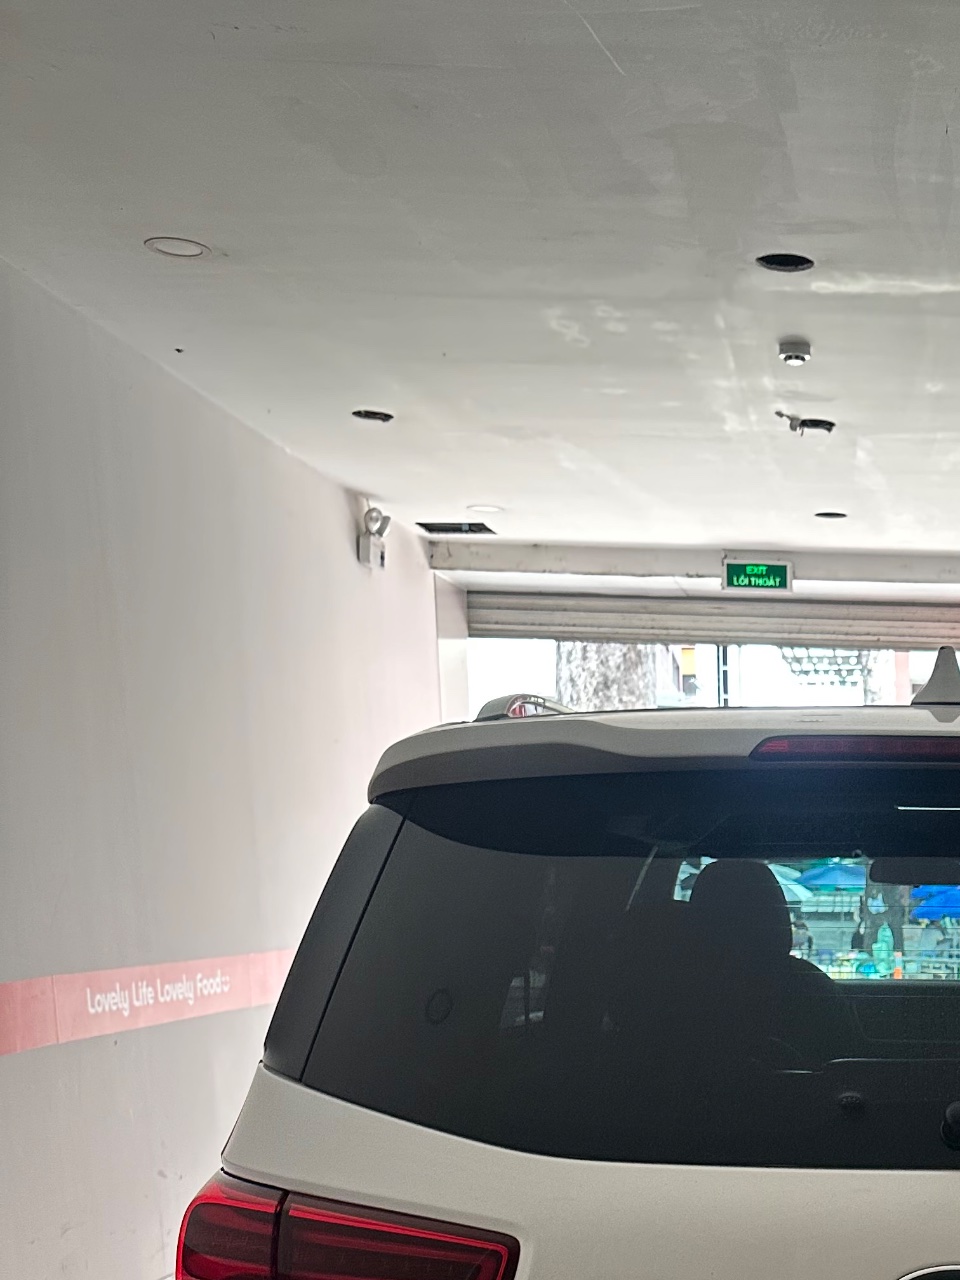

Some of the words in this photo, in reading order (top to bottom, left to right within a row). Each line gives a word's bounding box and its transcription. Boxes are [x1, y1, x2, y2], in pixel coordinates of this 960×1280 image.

[746, 566, 767, 575] EXIT
[86, 982, 130, 1017] Lovely
[132, 979, 155, 1007] Life
[156, 973, 195, 1005] Lovely
[196, 968, 222, 997] Food
